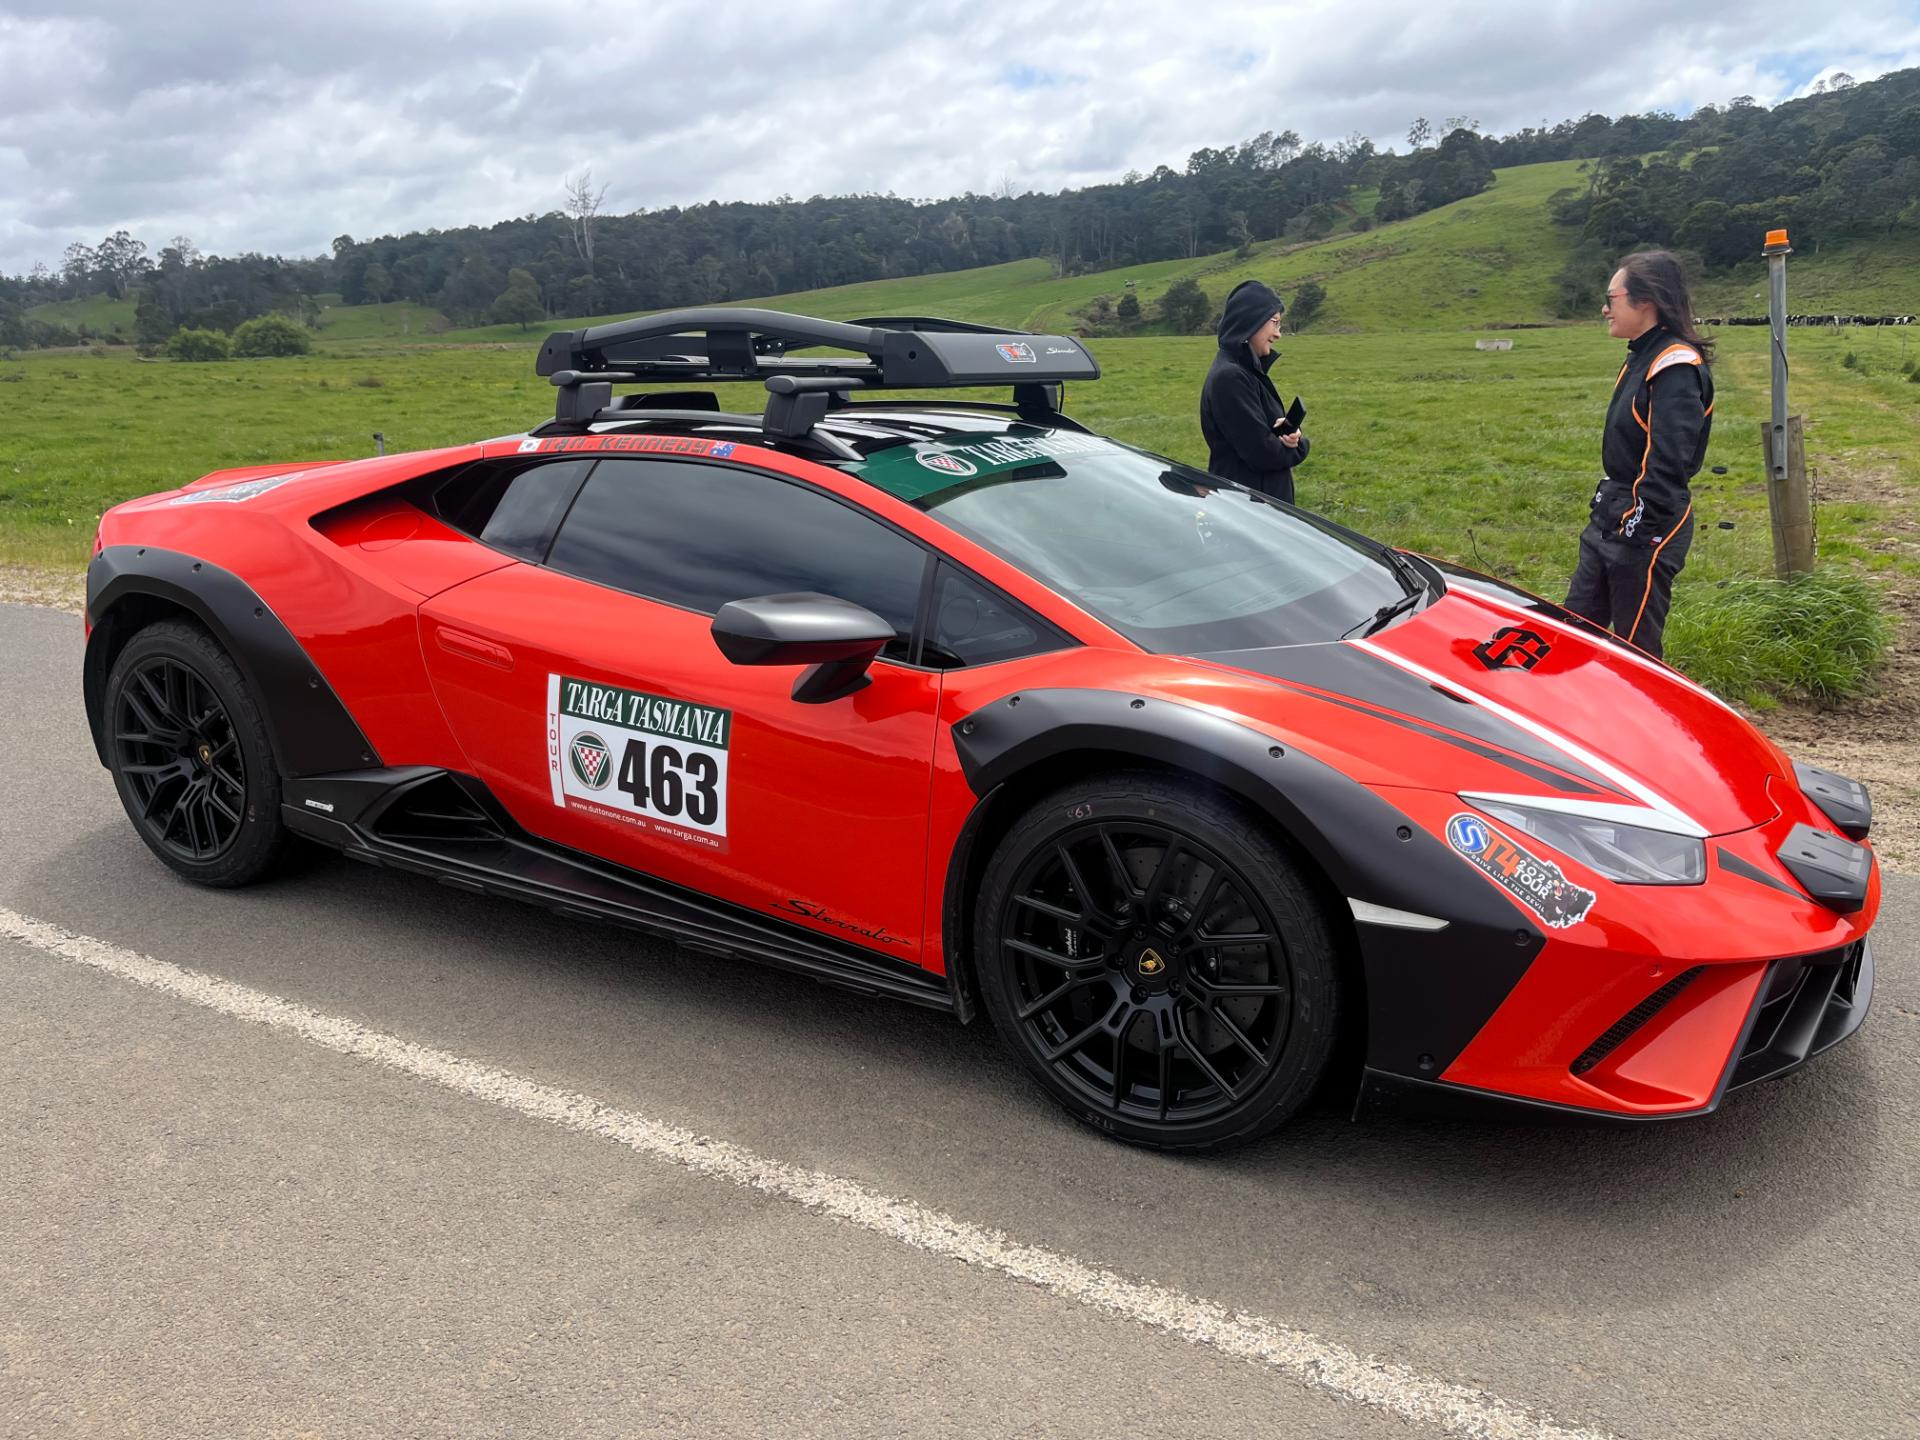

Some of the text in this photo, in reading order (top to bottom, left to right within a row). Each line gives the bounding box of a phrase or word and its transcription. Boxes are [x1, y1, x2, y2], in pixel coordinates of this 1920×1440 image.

[567, 682, 724, 744] TARGA TASMANIA
[549, 713, 558, 771] TOUR
[618, 738, 718, 826] 463
[654, 824, 719, 848] www.targa.com.au
[1471, 854, 1492, 871] DRIVE
[1493, 870, 1509, 884] LIKE
[1510, 882, 1525, 896] THE
[1525, 895, 1545, 913] DEVIL
[1514, 865, 1549, 900] TOUR
[1519, 859, 1553, 890] 2025
[768, 899, 912, 946] Sterrato
